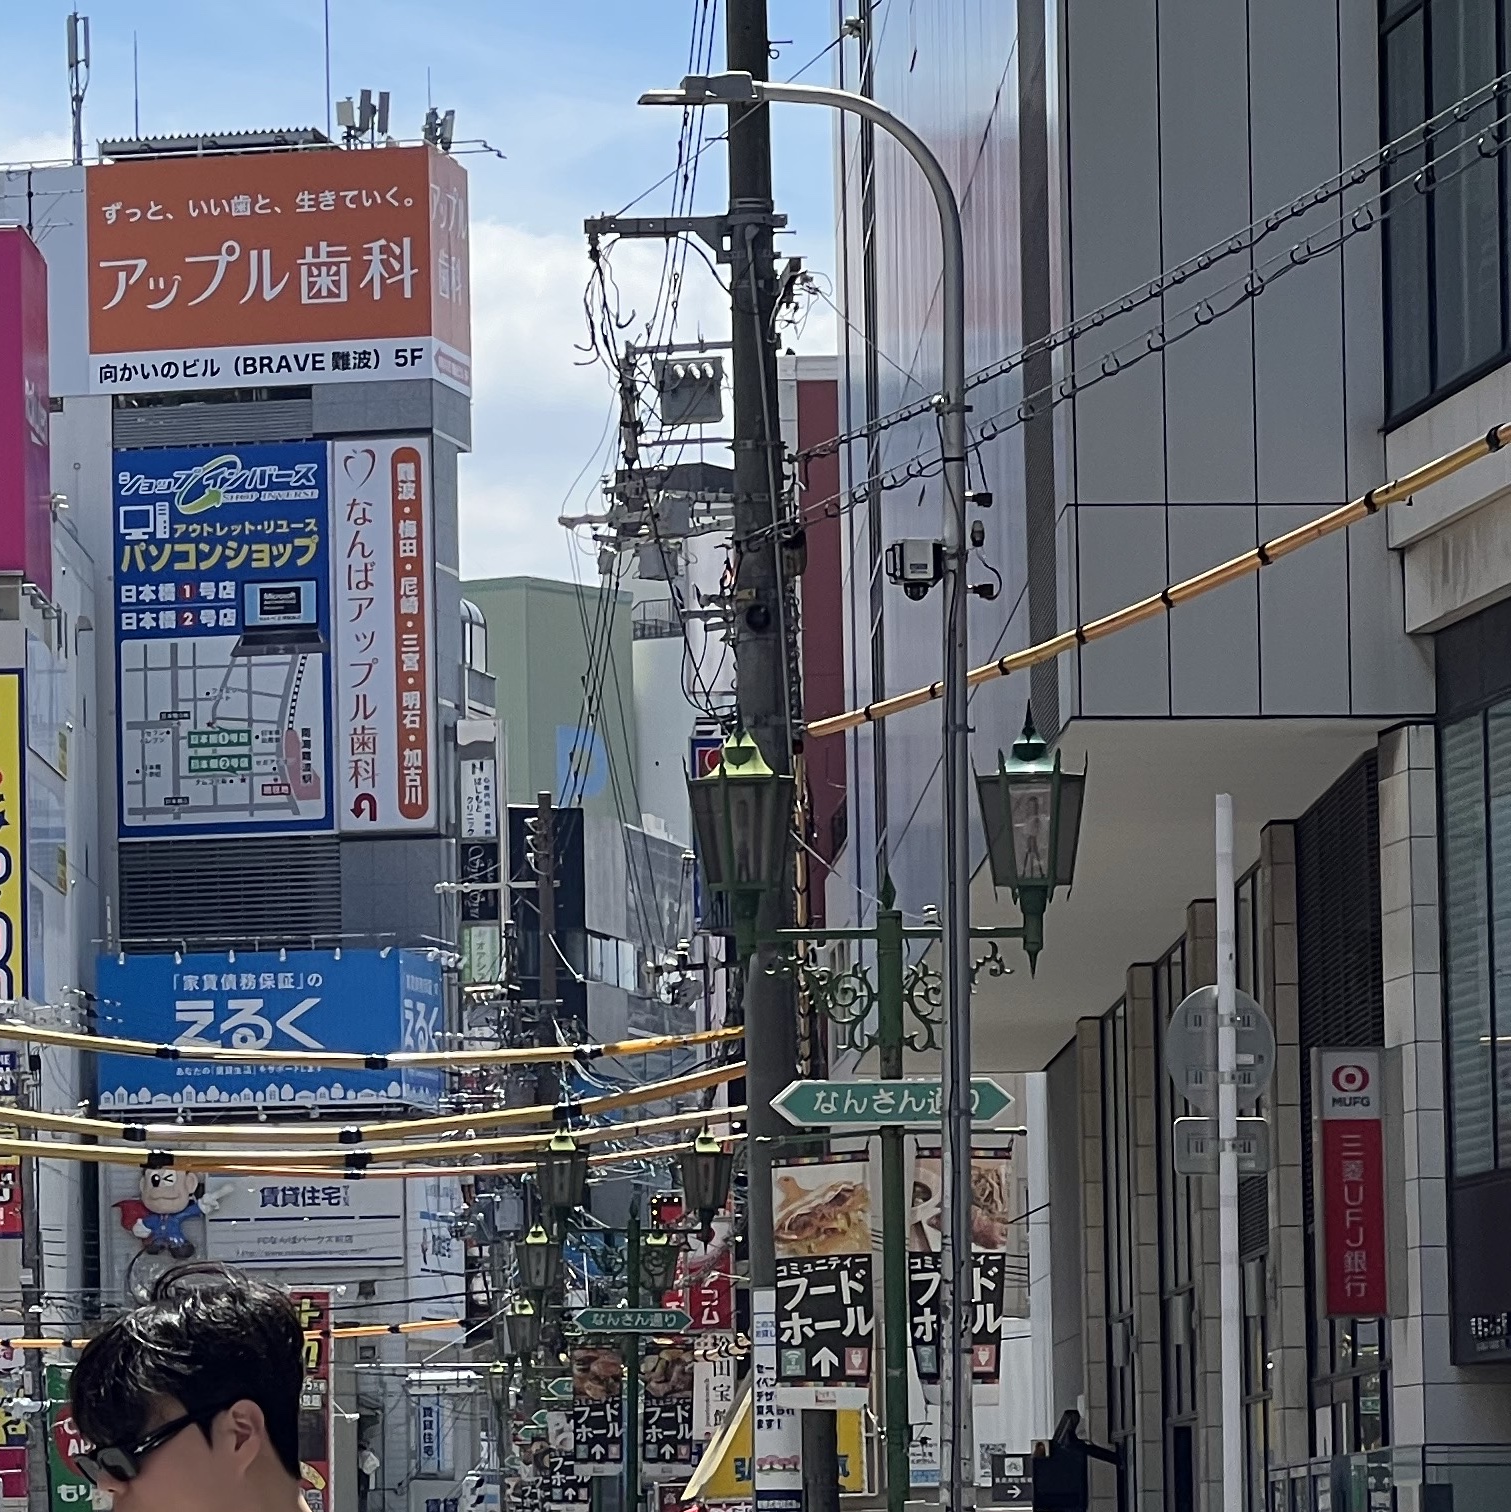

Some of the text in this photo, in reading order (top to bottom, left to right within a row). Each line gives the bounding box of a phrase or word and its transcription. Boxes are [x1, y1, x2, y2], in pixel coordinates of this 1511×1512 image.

[102, 187, 414, 225] ずっと、いい歯と、生きていく。
[99, 237, 419, 311] アップル歯科
[99, 357, 221, 385] 向かいのビル
[394, 348, 424, 368] 5F
[173, 518, 319, 538] アウトレット・リユース
[121, 534, 320, 573] パソコンショップ
[347, 498, 378, 789] なんばアップル歯科
[175, 997, 326, 1051] えるく
[1331, 1096, 1370, 1108] MUFG
[260, 1186, 341, 1208] 賃貸住宅
[1340, 1133, 1368, 1299] 三菱UFJ銀行
[776, 1256, 868, 1277] コミュニティー
[777, 1269, 866, 1311] フード
[911, 1267, 999, 1307] フド
[592, 1312, 677, 1328] なんさん通り
[779, 1305, 874, 1346] ホール
[913, 1304, 1004, 1342] ホル
[574, 1403, 619, 1424] フード
[645, 1404, 691, 1424] フード
[576, 1423, 624, 1442] ホール
[645, 1423, 693, 1442] ホール
